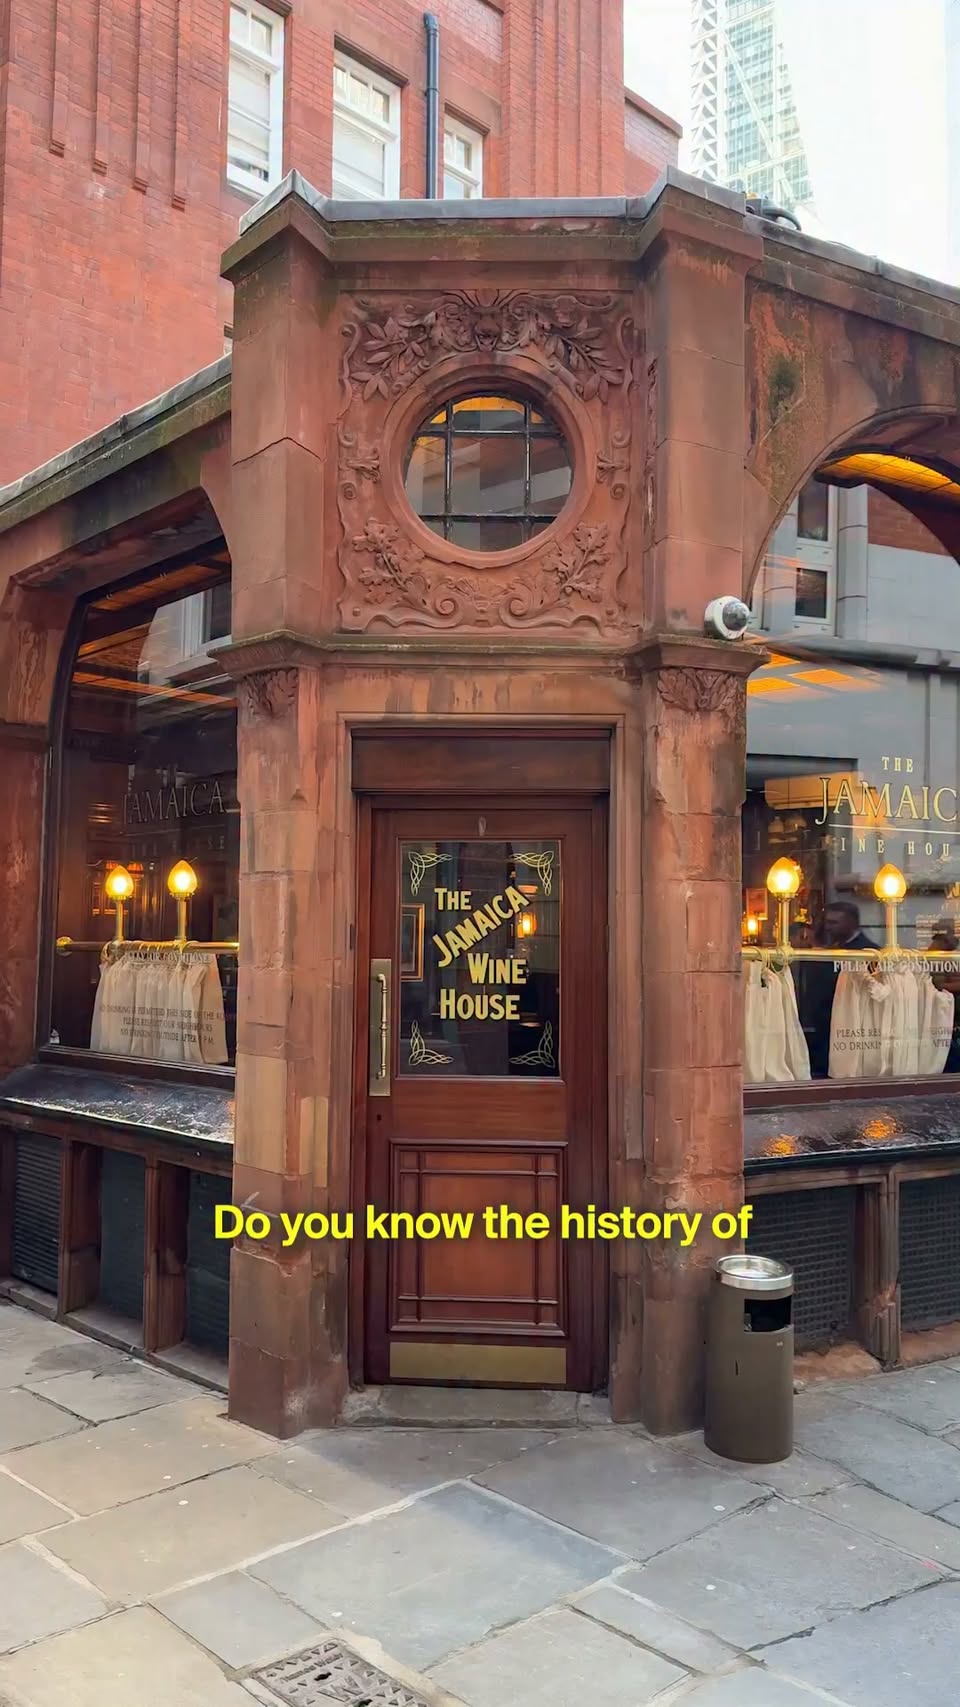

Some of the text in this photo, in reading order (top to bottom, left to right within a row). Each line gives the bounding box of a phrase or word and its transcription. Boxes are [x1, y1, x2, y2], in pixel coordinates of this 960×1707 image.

[881, 756, 914, 774] THE
[119, 780, 225, 836] JAMAICA
[434, 887, 472, 911] THE
[431, 885, 531, 969] JAMAICA
[467, 952, 528, 985] WINE
[833, 960, 871, 973] FULLY
[876, 960, 895, 973] AIR
[440, 988, 522, 1021] HOUSE
[836, 1028, 865, 1038] PLEASE
[832, 1041, 847, 1051] NO
